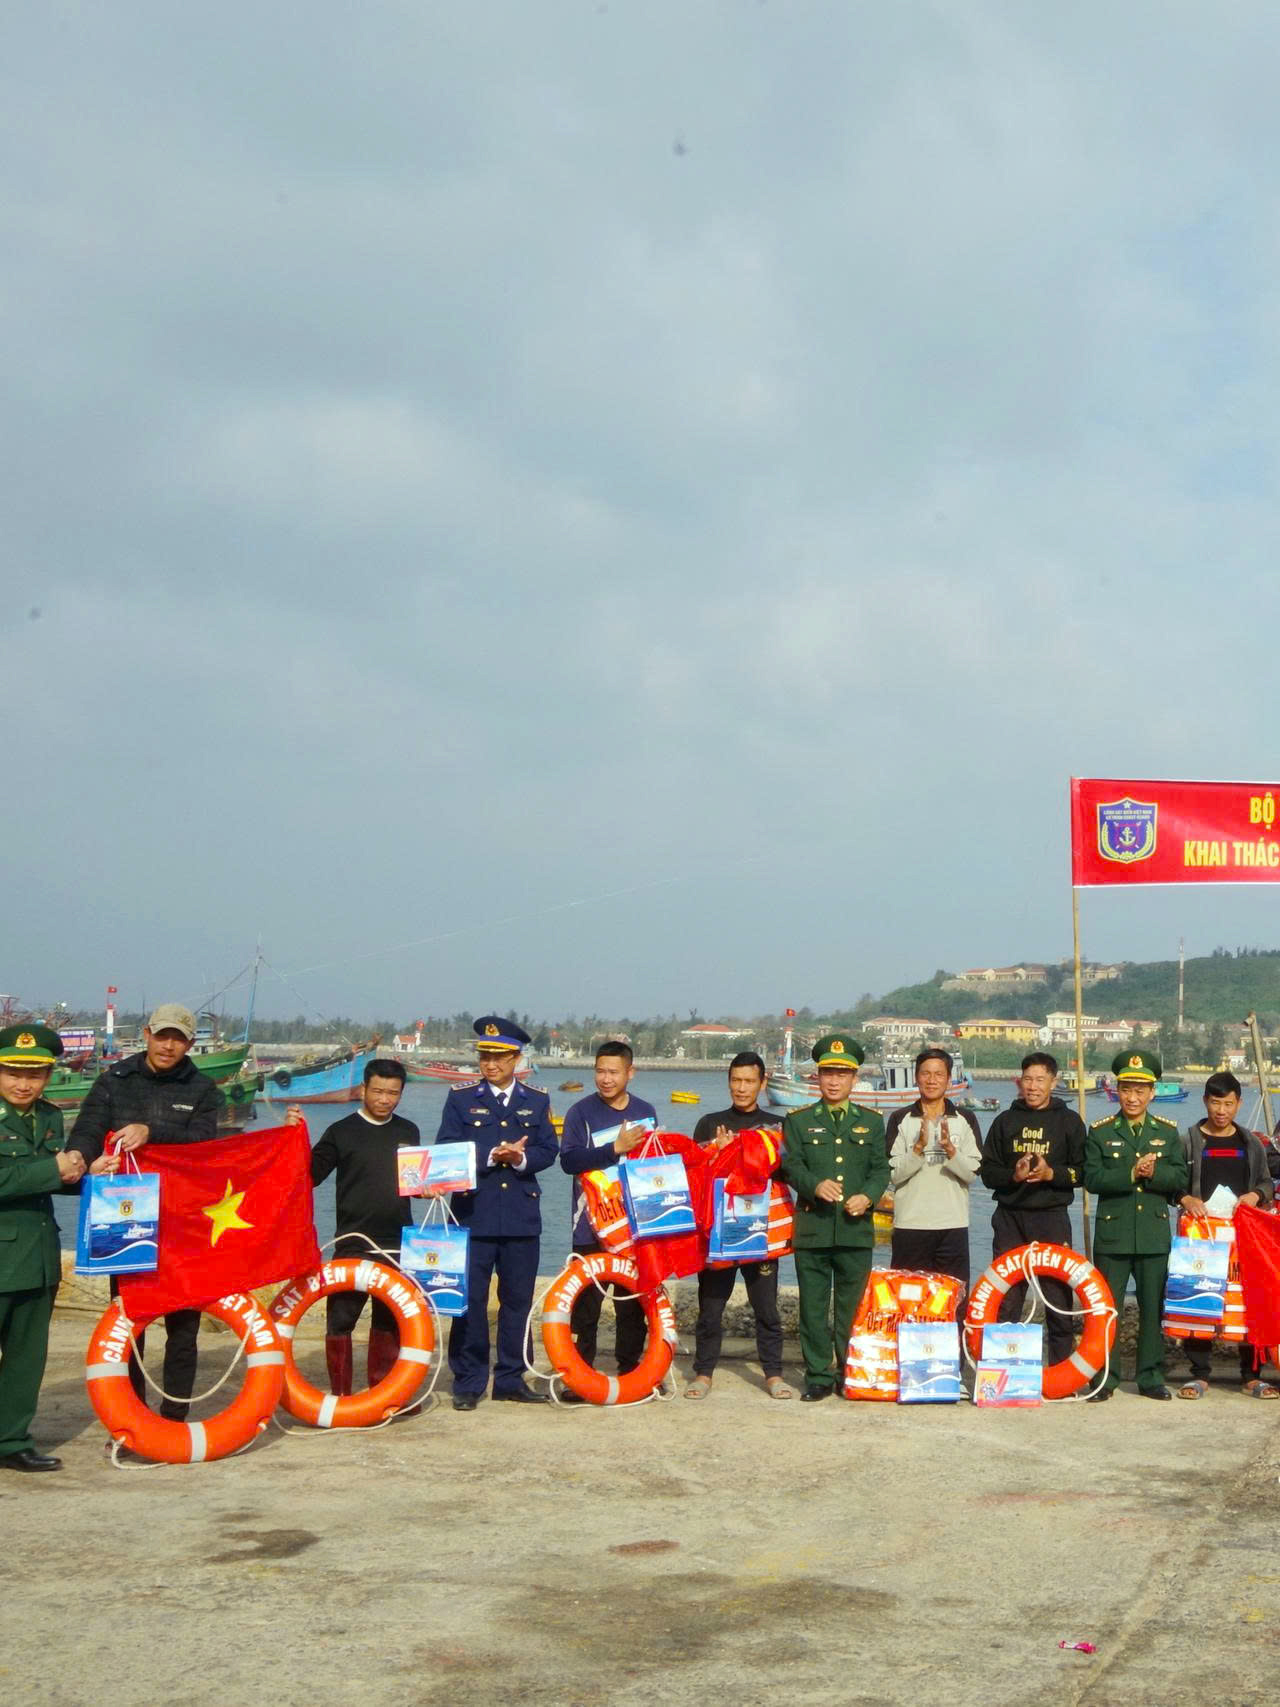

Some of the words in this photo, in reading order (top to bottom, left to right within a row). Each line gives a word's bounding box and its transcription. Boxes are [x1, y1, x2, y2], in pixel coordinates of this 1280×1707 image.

[1250, 792, 1275, 830] BỘ
[1184, 840, 1227, 867] KHAI
[1232, 837, 1280, 868] THÁC
[1022, 1127, 1043, 1139] Good
[387, 1282, 421, 1319] NAM
[970, 1281, 994, 1320] CẢNH
